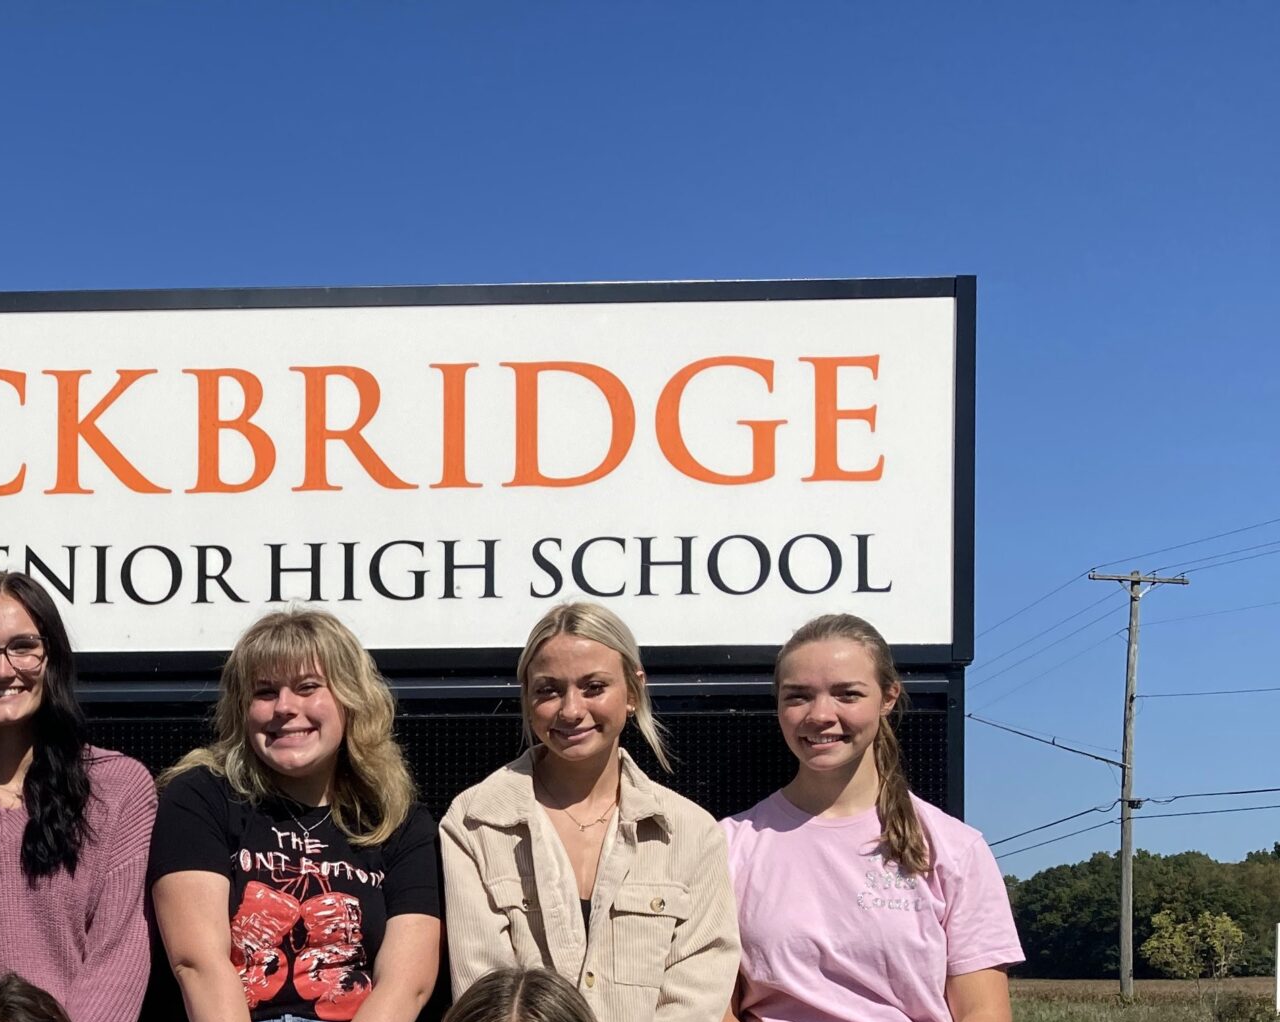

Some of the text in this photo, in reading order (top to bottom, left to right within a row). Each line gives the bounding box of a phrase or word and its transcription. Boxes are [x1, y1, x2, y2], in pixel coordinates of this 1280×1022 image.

[266, 538, 503, 602] HIGH
[529, 532, 893, 598] SCHOOL
[271, 827, 329, 854] THE
[230, 848, 291, 872] ONT
